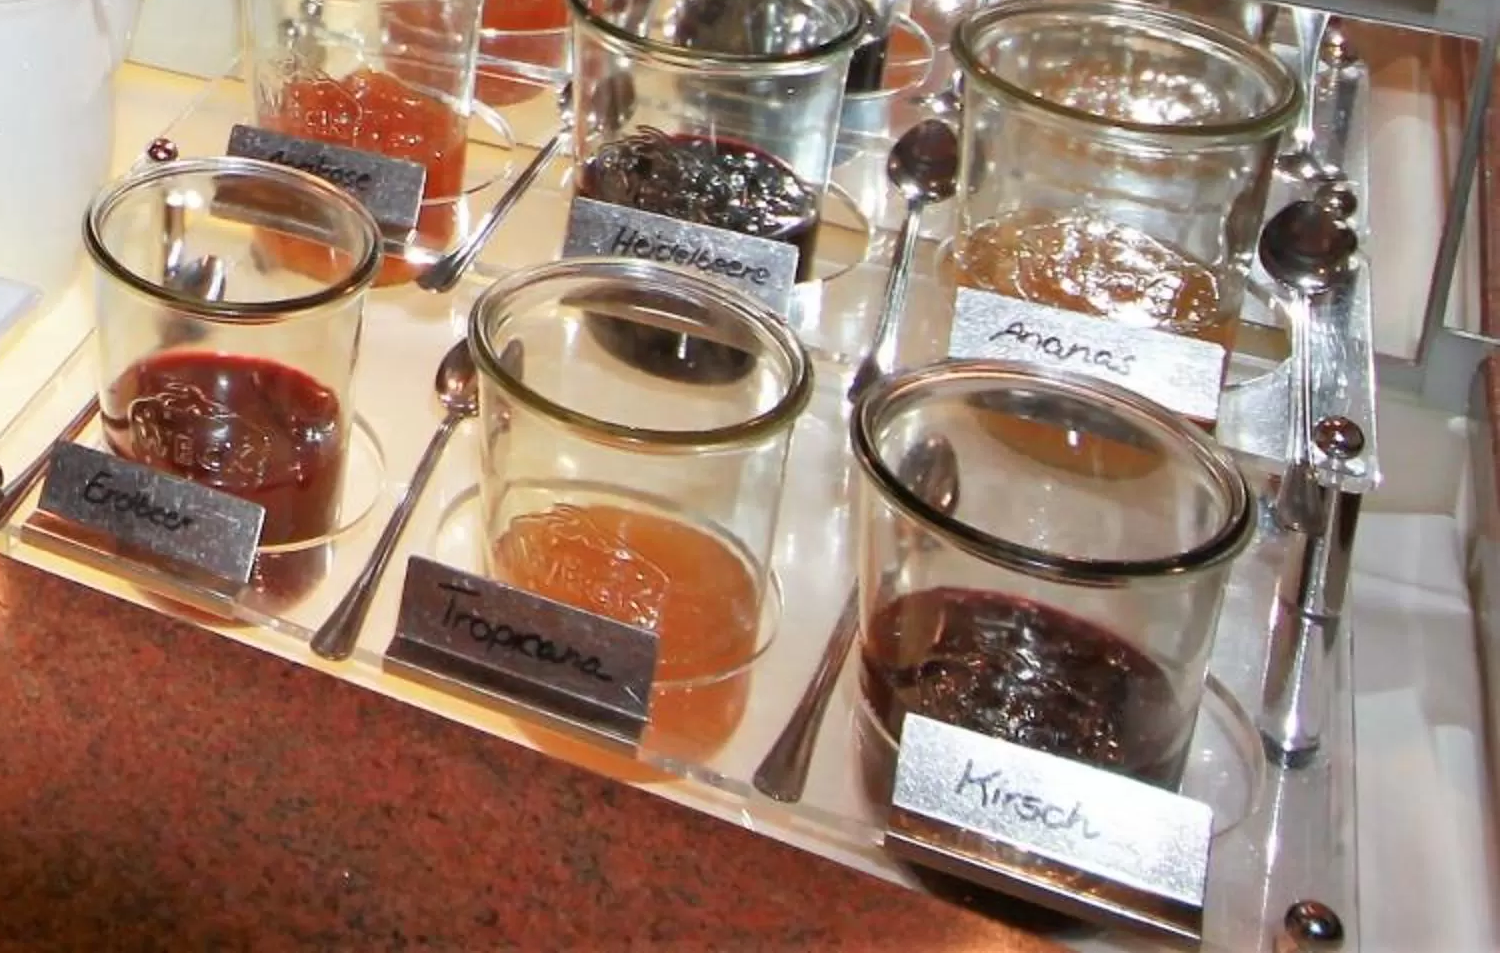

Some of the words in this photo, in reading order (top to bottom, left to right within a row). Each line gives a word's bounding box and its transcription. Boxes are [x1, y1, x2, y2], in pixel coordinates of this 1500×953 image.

[612, 226, 771, 285] Heidelbeere
[989, 321, 1136, 375] Ananas
[84, 470, 194, 531] Erdbeer
[437, 582, 613, 682] Tropicana
[955, 758, 1101, 840] Kirsch
